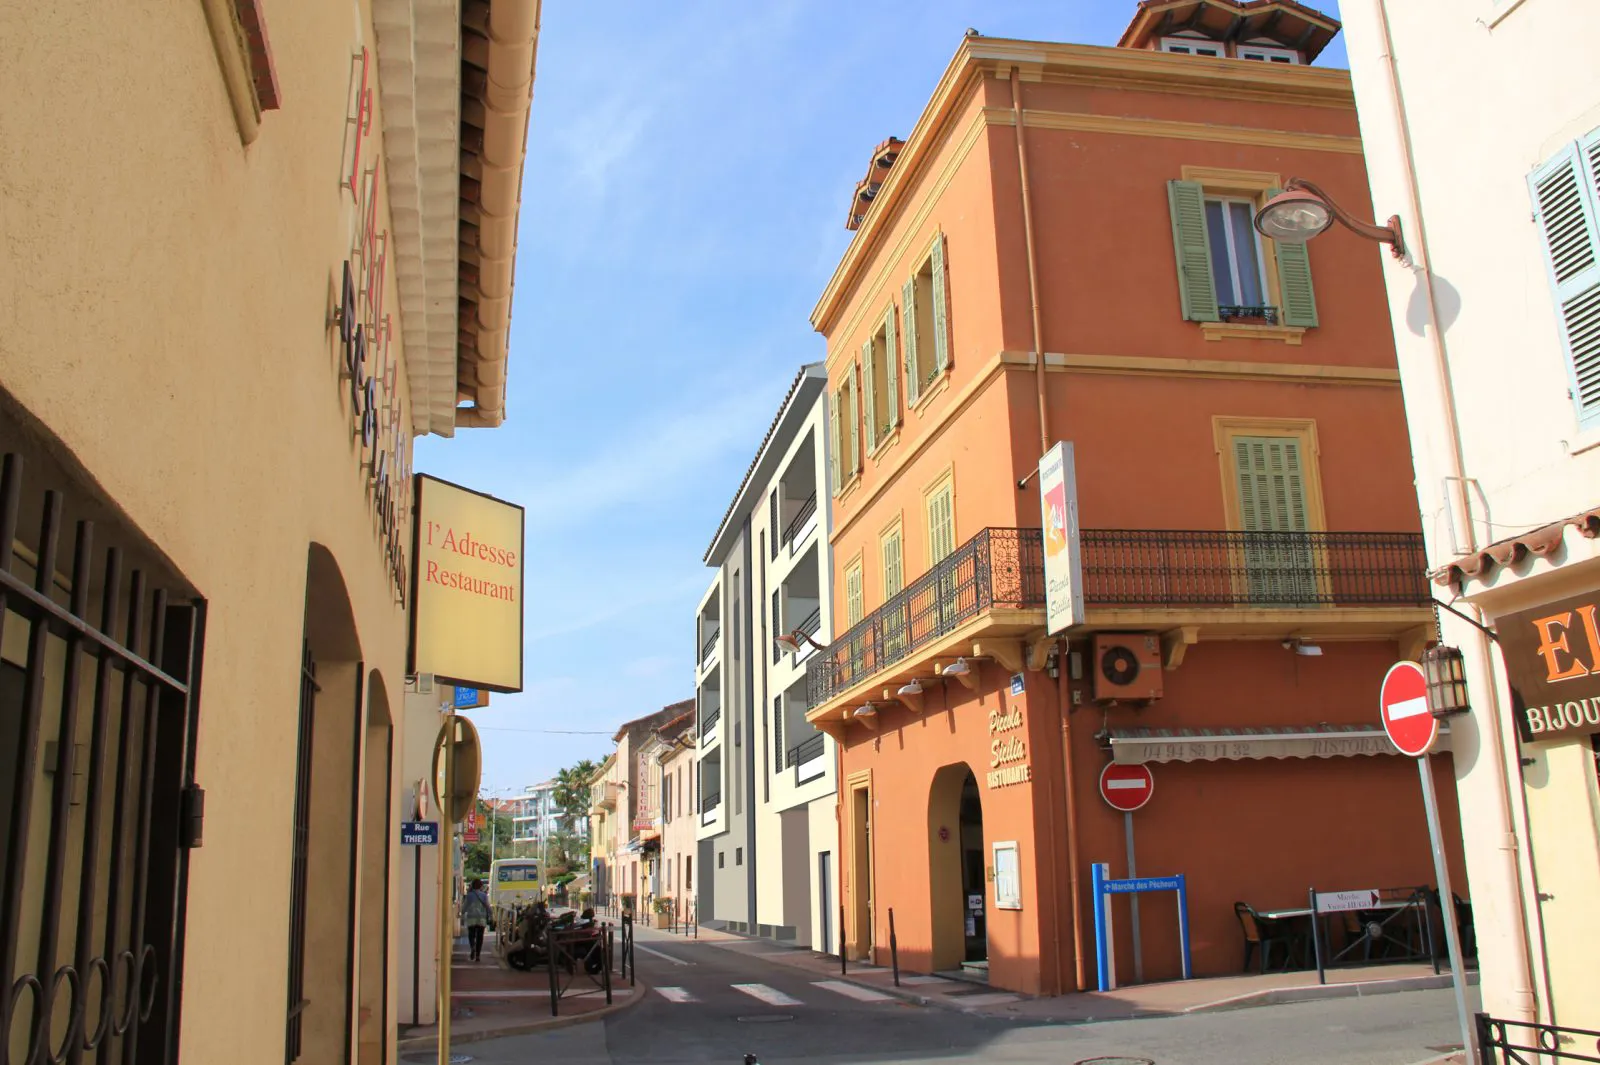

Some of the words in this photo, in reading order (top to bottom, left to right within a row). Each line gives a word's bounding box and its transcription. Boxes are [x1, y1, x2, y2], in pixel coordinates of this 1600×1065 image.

[427, 521, 516, 568] l'Adresse
[426, 560, 515, 602] Restaurant
[989, 704, 1023, 737] Piccola
[1526, 697, 1600, 733] BIJOU
[990, 736, 1026, 768] Sicilia
[987, 764, 1030, 789] RISTORANTE
[404, 834, 433, 844] THIERS
[414, 823, 430, 831] Rue
[1136, 881, 1148, 889] des
